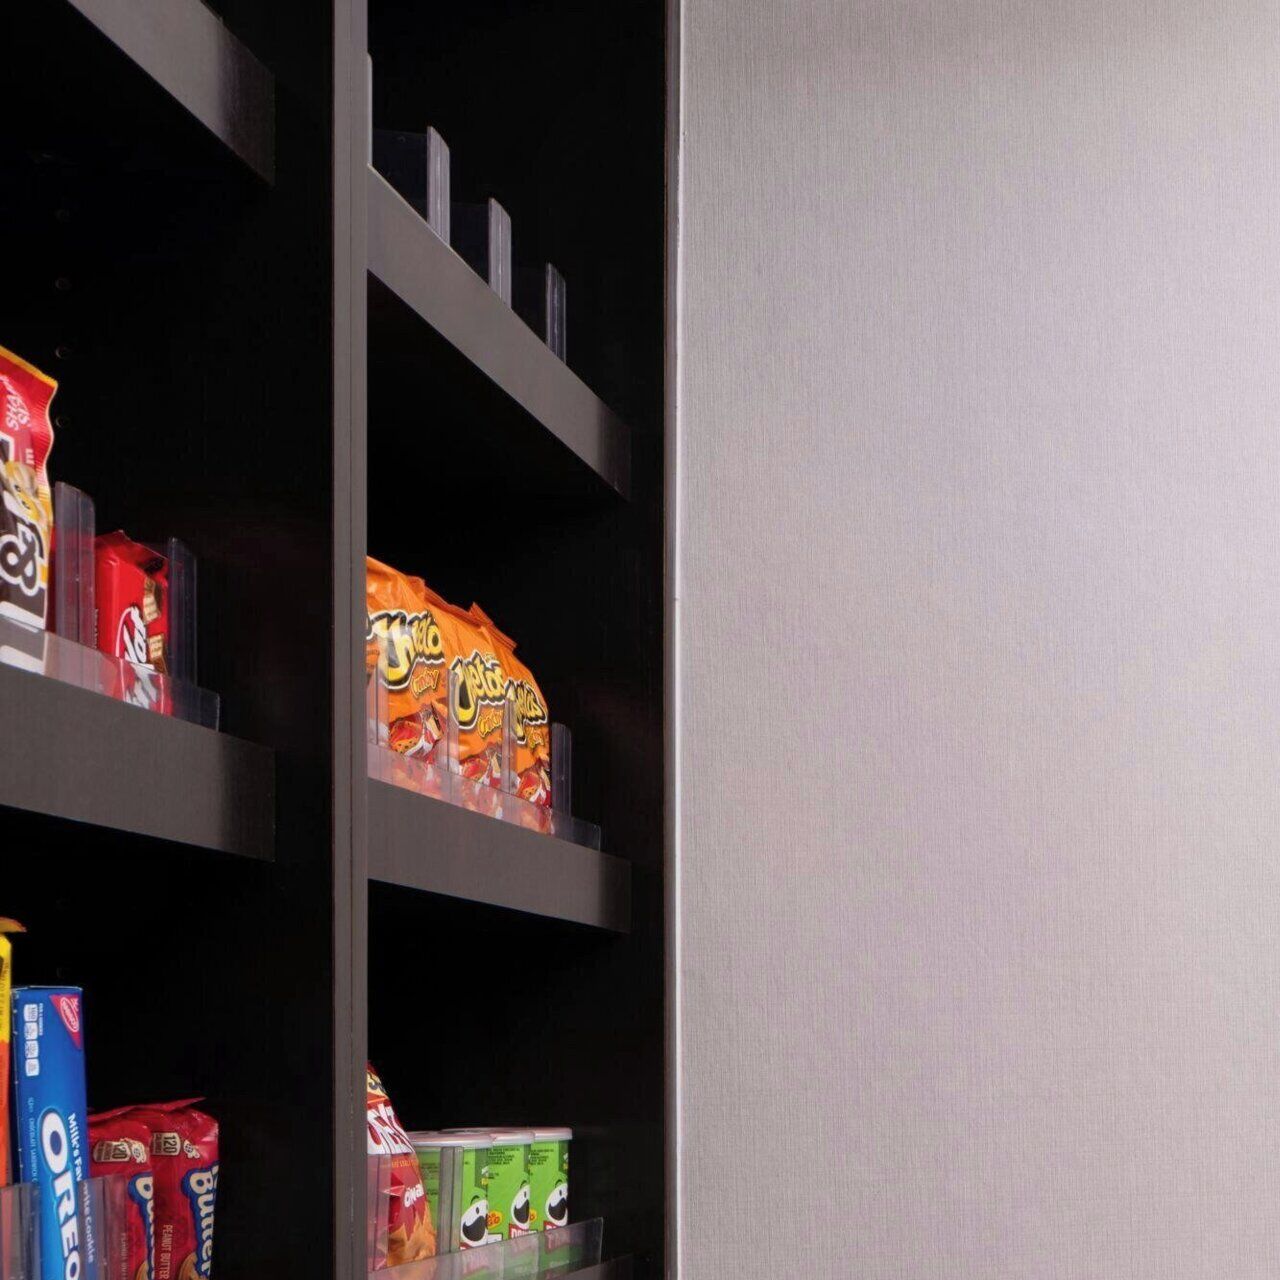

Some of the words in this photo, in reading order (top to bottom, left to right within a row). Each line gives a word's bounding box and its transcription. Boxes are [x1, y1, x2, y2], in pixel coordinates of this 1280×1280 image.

[67, 1112, 81, 1159] Milk's
[162, 1135, 176, 1154] 120
[162, 1224, 174, 1252] PEANUT
[189, 1171, 216, 1277] Butter
[159, 1252, 171, 1280] BUTTER
